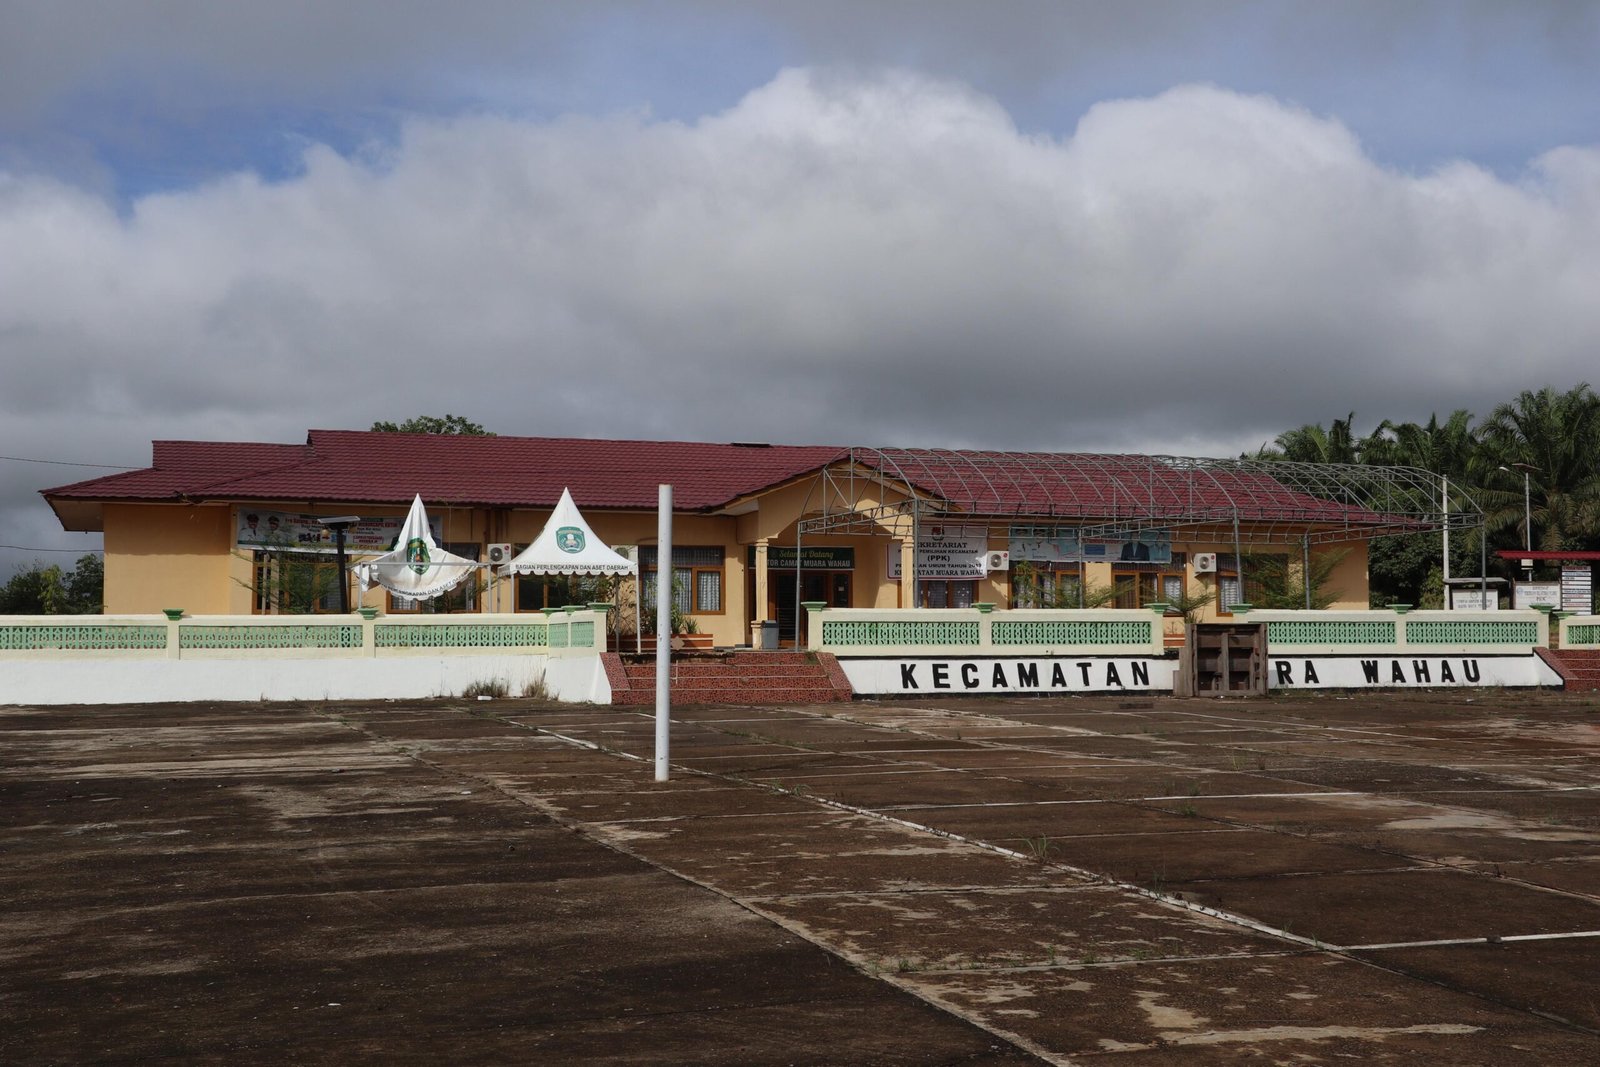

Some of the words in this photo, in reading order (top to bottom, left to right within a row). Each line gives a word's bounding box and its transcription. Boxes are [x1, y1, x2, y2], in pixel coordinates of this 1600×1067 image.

[809, 550, 834, 561] Datang
[900, 661, 1150, 689] KECAMATAN
[1361, 659, 1481, 684] WAHAU
